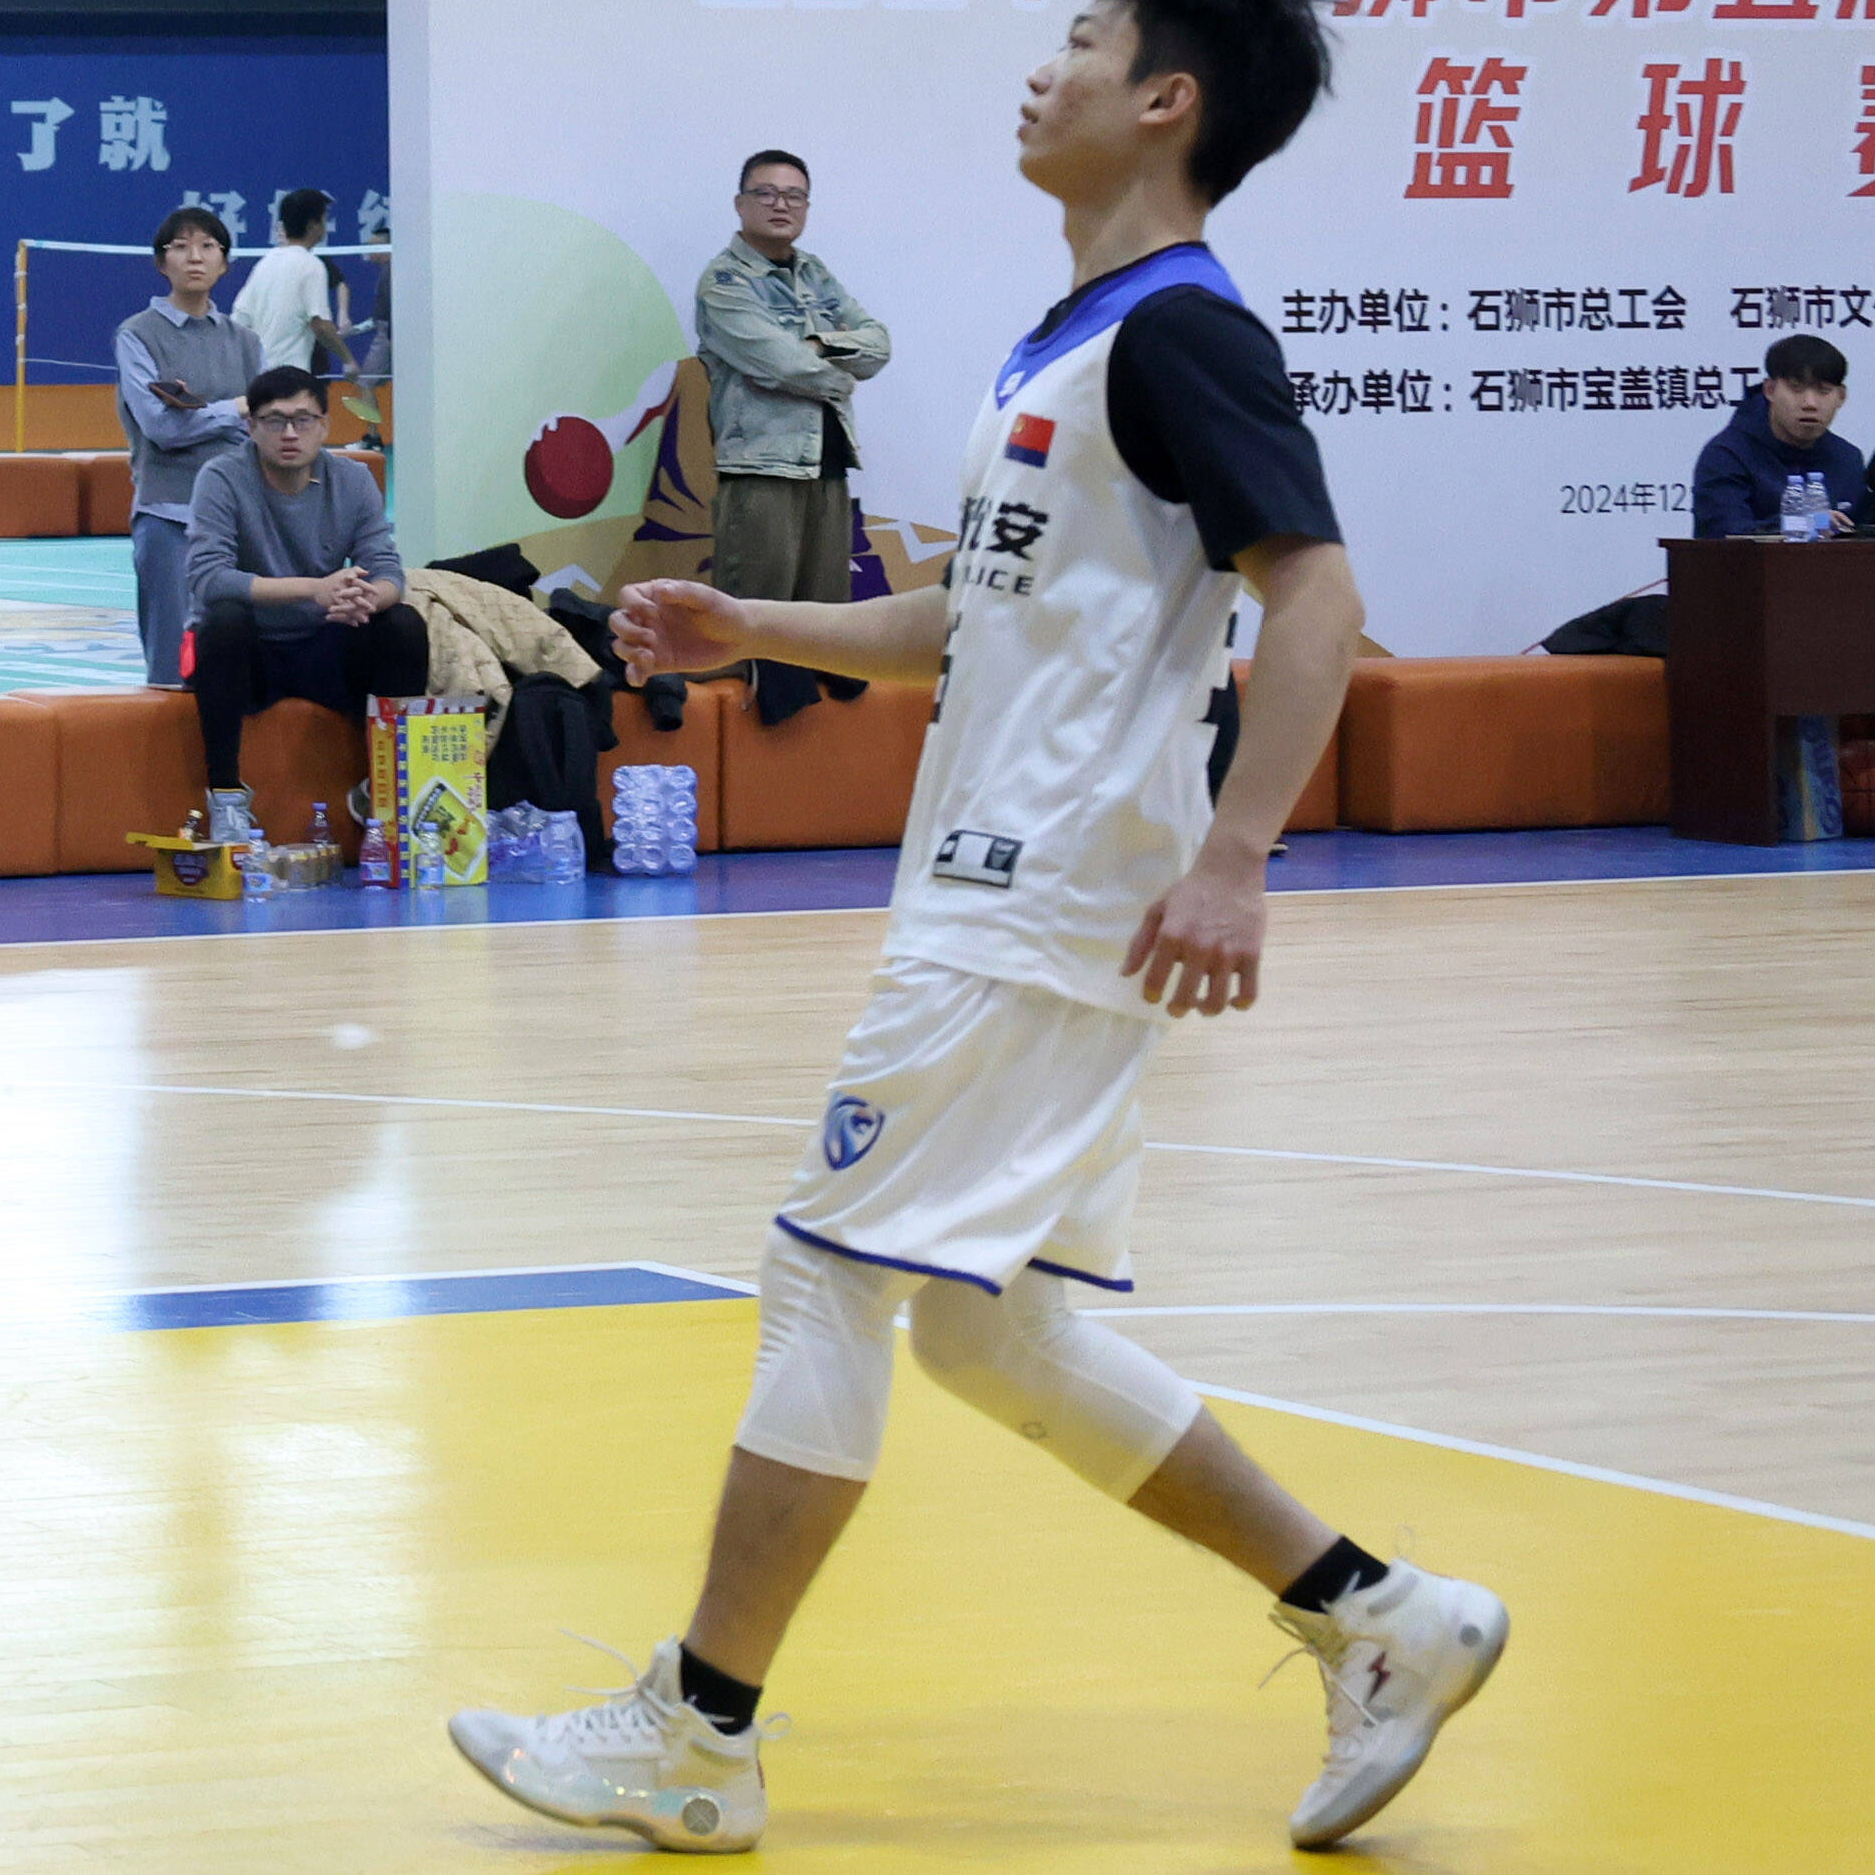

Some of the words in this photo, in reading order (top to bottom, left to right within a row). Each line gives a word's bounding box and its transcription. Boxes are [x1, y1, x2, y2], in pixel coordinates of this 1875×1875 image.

[1730, 284, 1875, 330] 石狮市文
[1559, 481, 1694, 516] 2024年12
[961, 563, 1036, 598] LICE
